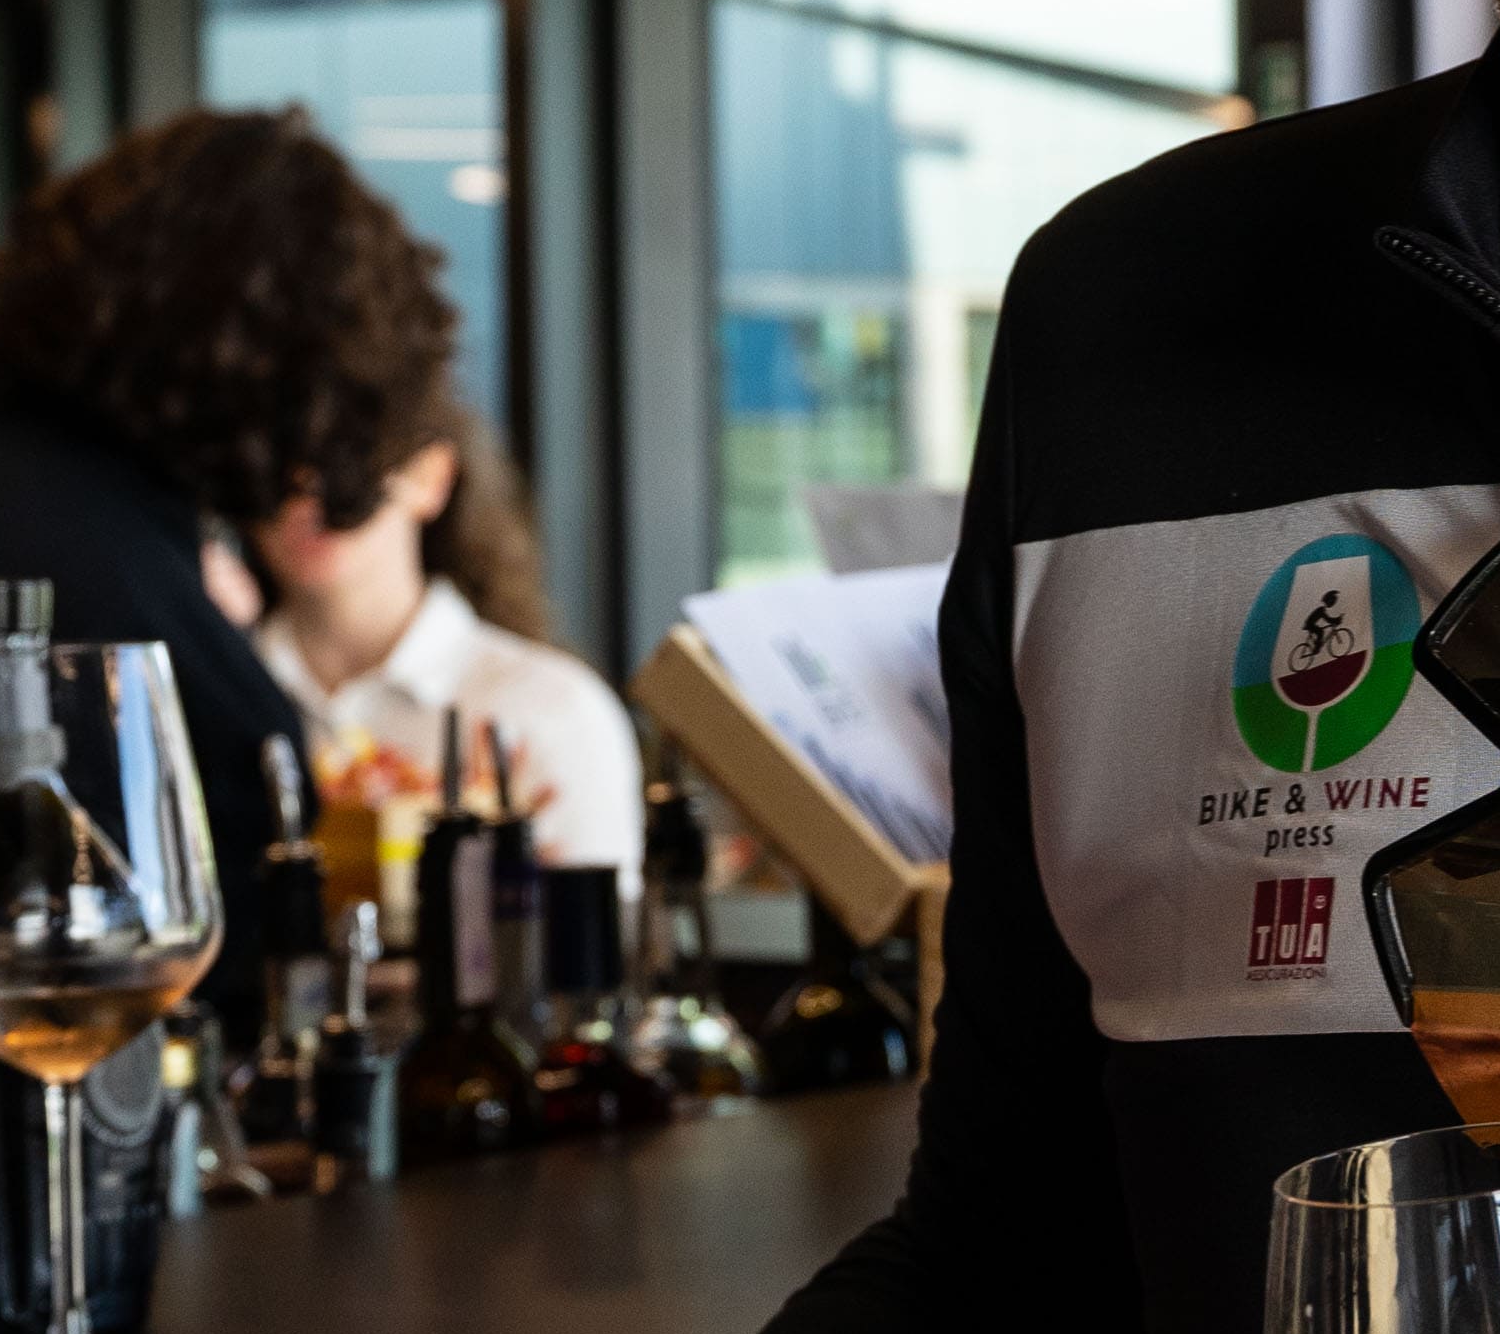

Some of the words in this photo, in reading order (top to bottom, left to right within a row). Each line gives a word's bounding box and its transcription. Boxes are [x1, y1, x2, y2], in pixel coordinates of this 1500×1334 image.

[1199, 788, 1271, 825] BIKE
[1285, 784, 1306, 815] &
[1324, 777, 1430, 810] WINE
[1265, 824, 1335, 857] press
[1255, 923, 1325, 961] TUA
